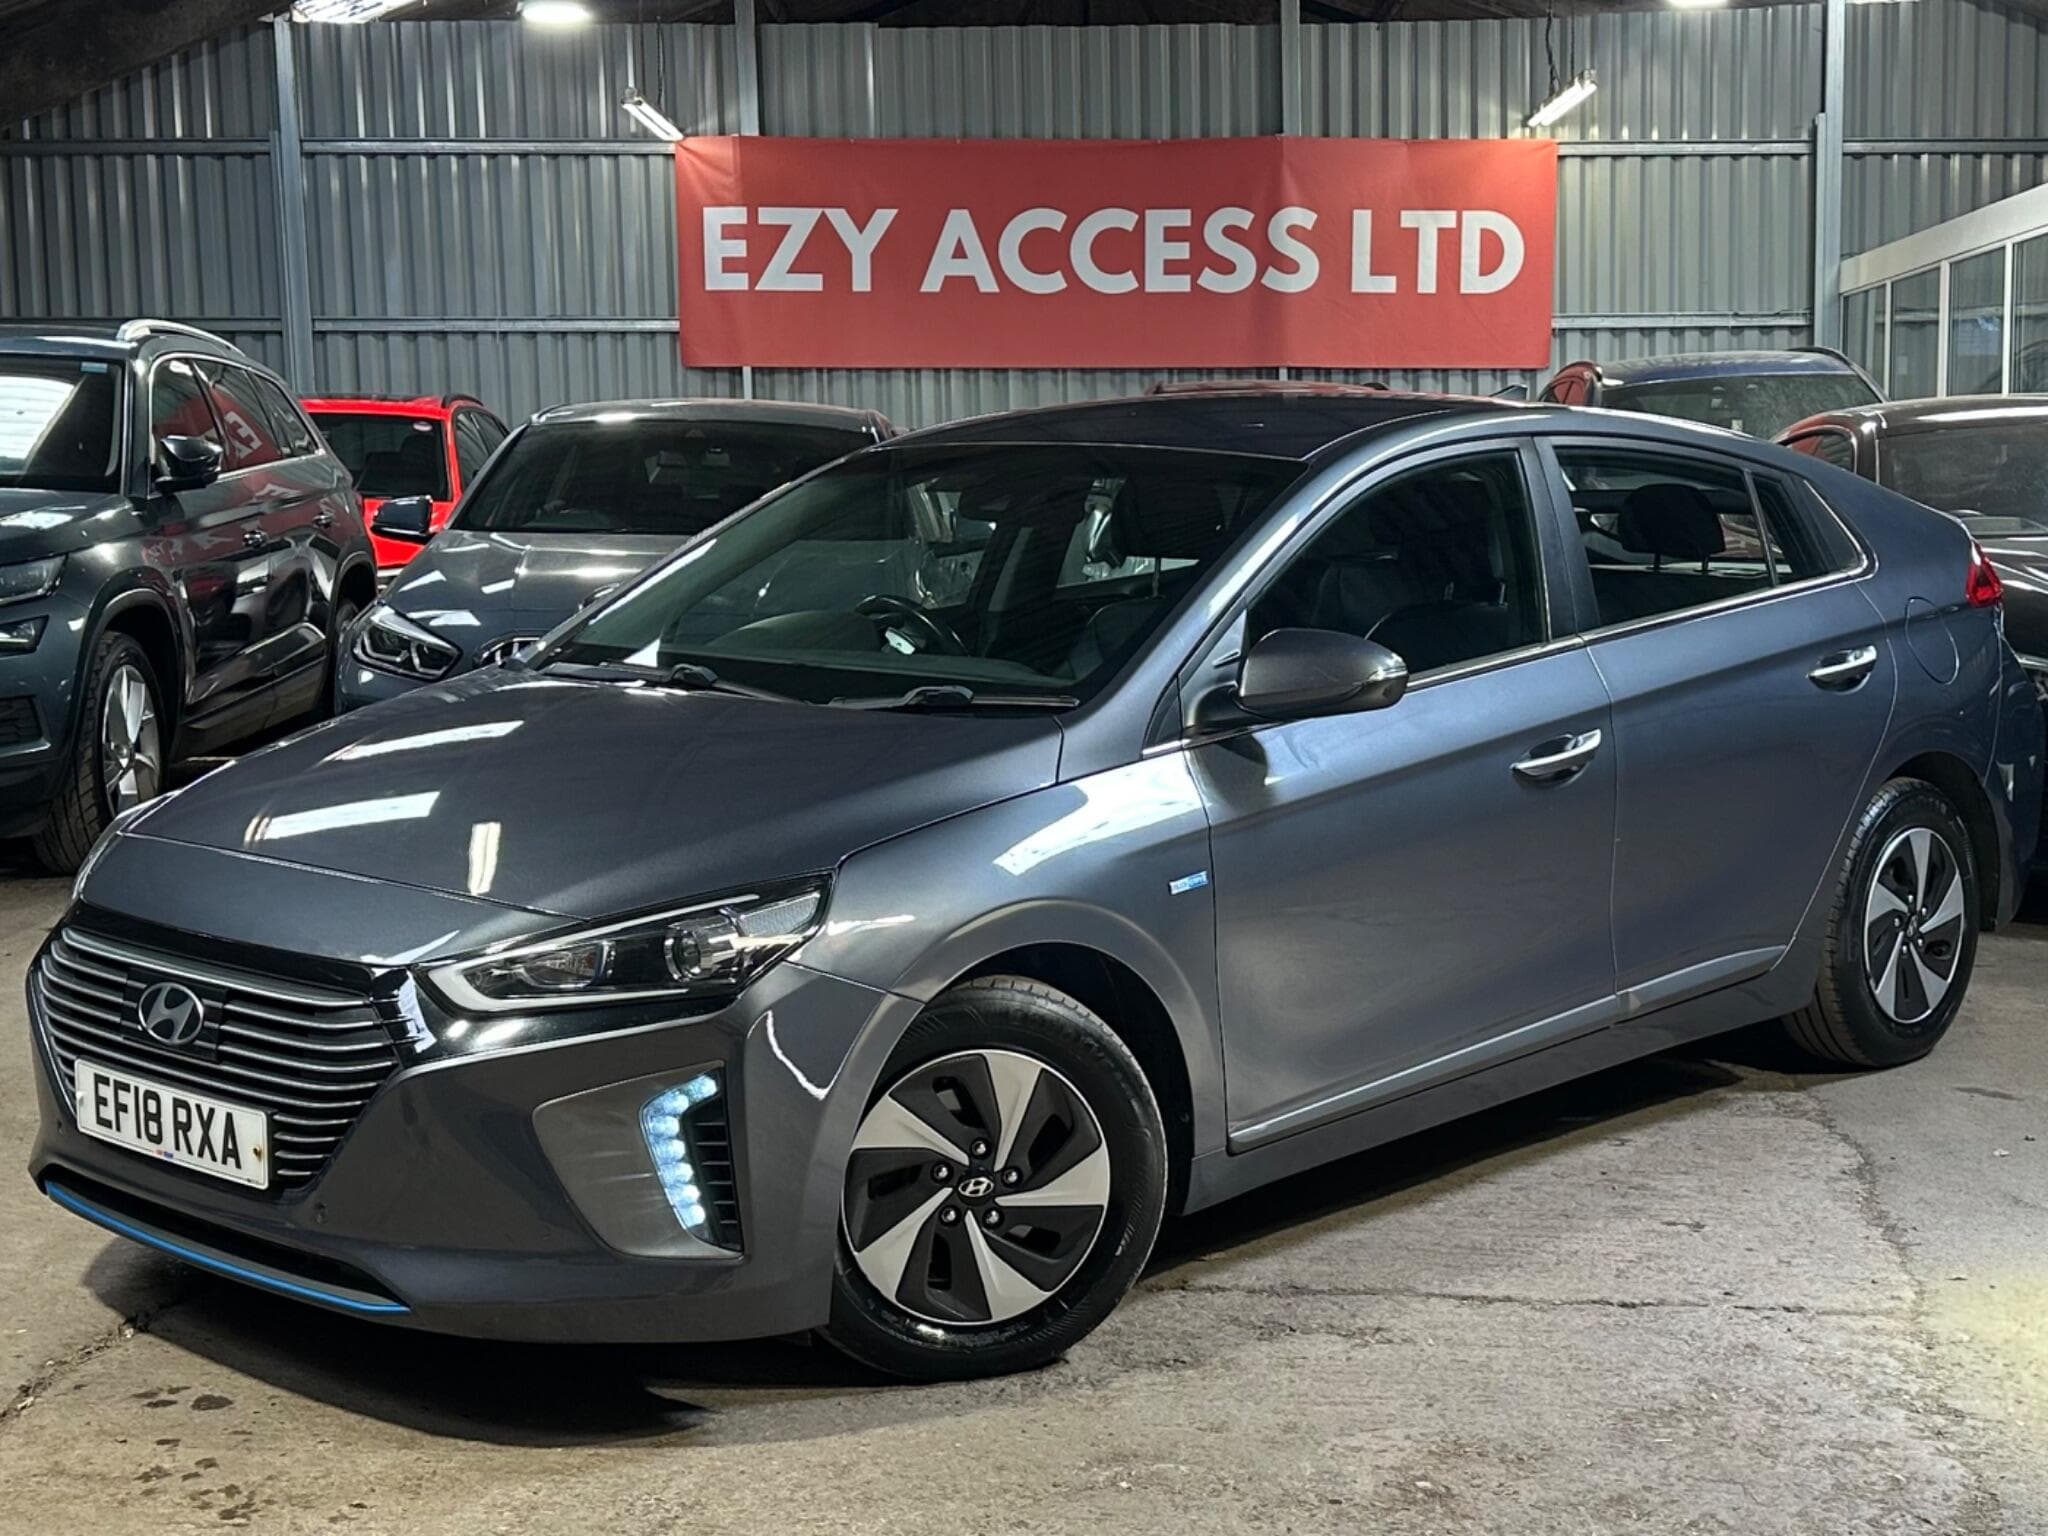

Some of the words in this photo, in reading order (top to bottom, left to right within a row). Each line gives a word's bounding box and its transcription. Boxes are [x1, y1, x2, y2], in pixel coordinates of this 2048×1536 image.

[702, 205, 899, 292] EZY
[919, 206, 1320, 294] ACCESS
[1351, 208, 1526, 295] LTD
[93, 1072, 164, 1145] EF18
[172, 1097, 242, 1170] RXA
